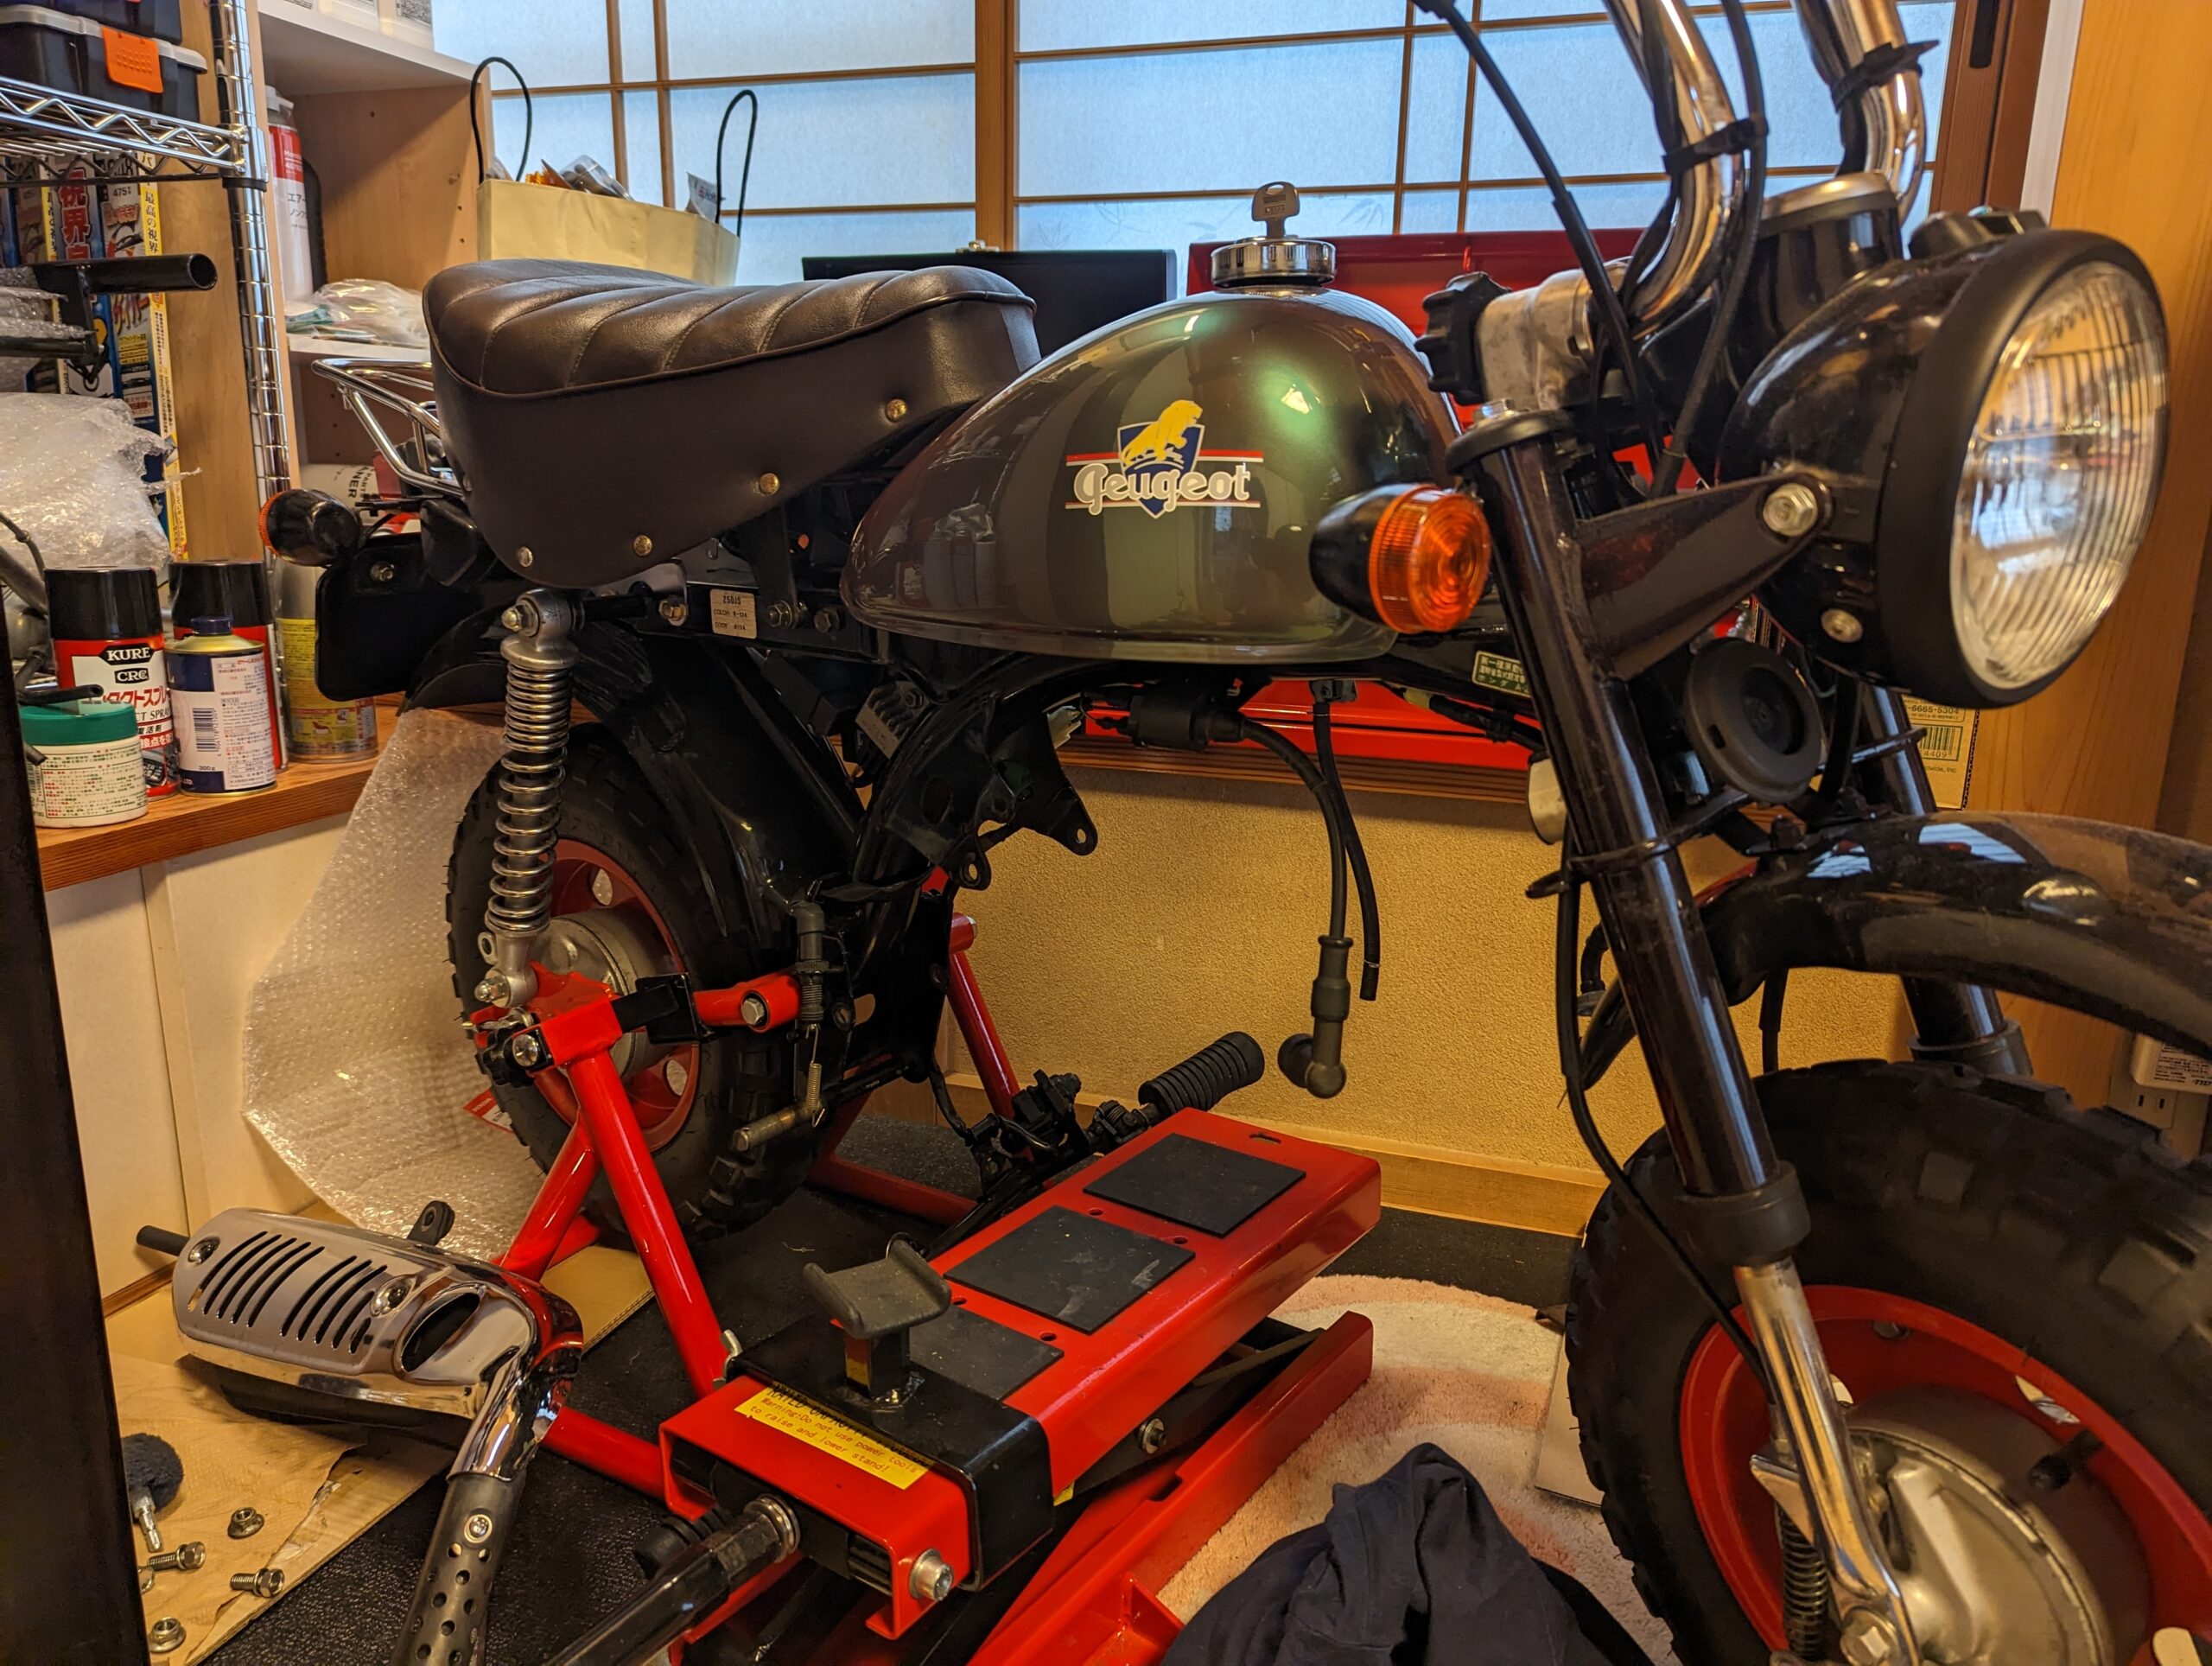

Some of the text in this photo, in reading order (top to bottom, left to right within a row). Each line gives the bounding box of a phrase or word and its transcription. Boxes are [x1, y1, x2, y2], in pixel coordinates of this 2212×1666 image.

[1074, 462, 1251, 516] Peugeot
[106, 646, 151, 662] KURE
[117, 670, 149, 682] CRC
[749, 1405, 763, 1414] to
[765, 1412, 794, 1428] raise
[796, 1427, 817, 1438] and
[821, 1435, 849, 1453] lower
[851, 1452, 891, 1473] stand!
[815, 1422, 832, 1434] not
[835, 1432, 854, 1442] use
[855, 1440, 886, 1457] power
[888, 1455, 918, 1474] tools
